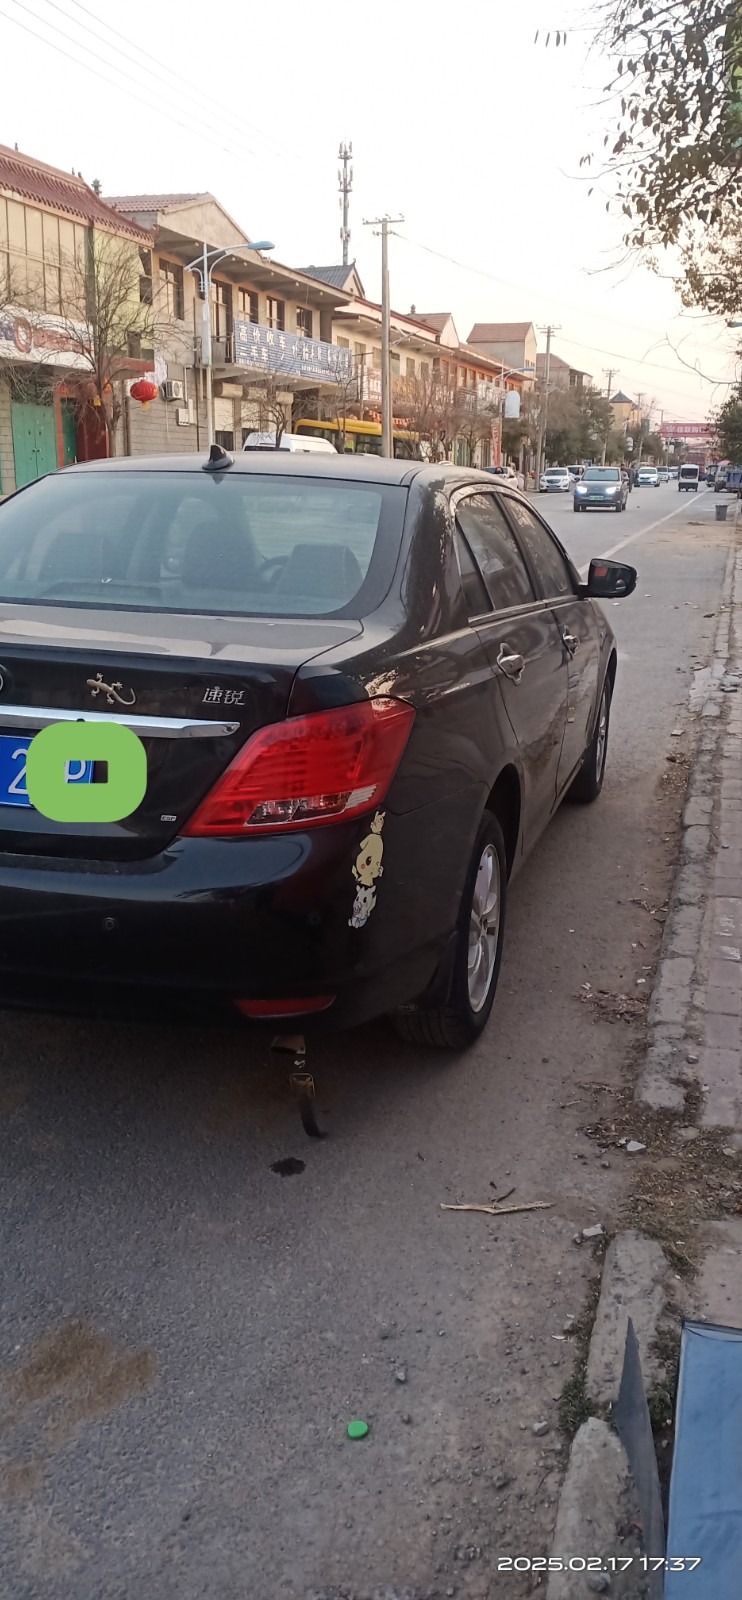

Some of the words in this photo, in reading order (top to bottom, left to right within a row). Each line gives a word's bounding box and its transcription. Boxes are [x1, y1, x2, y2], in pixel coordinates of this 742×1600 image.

[239, 324, 286, 350] 高价收车
[239, 345, 269, 363] 二手车
[202, 686, 246, 706] 速锐
